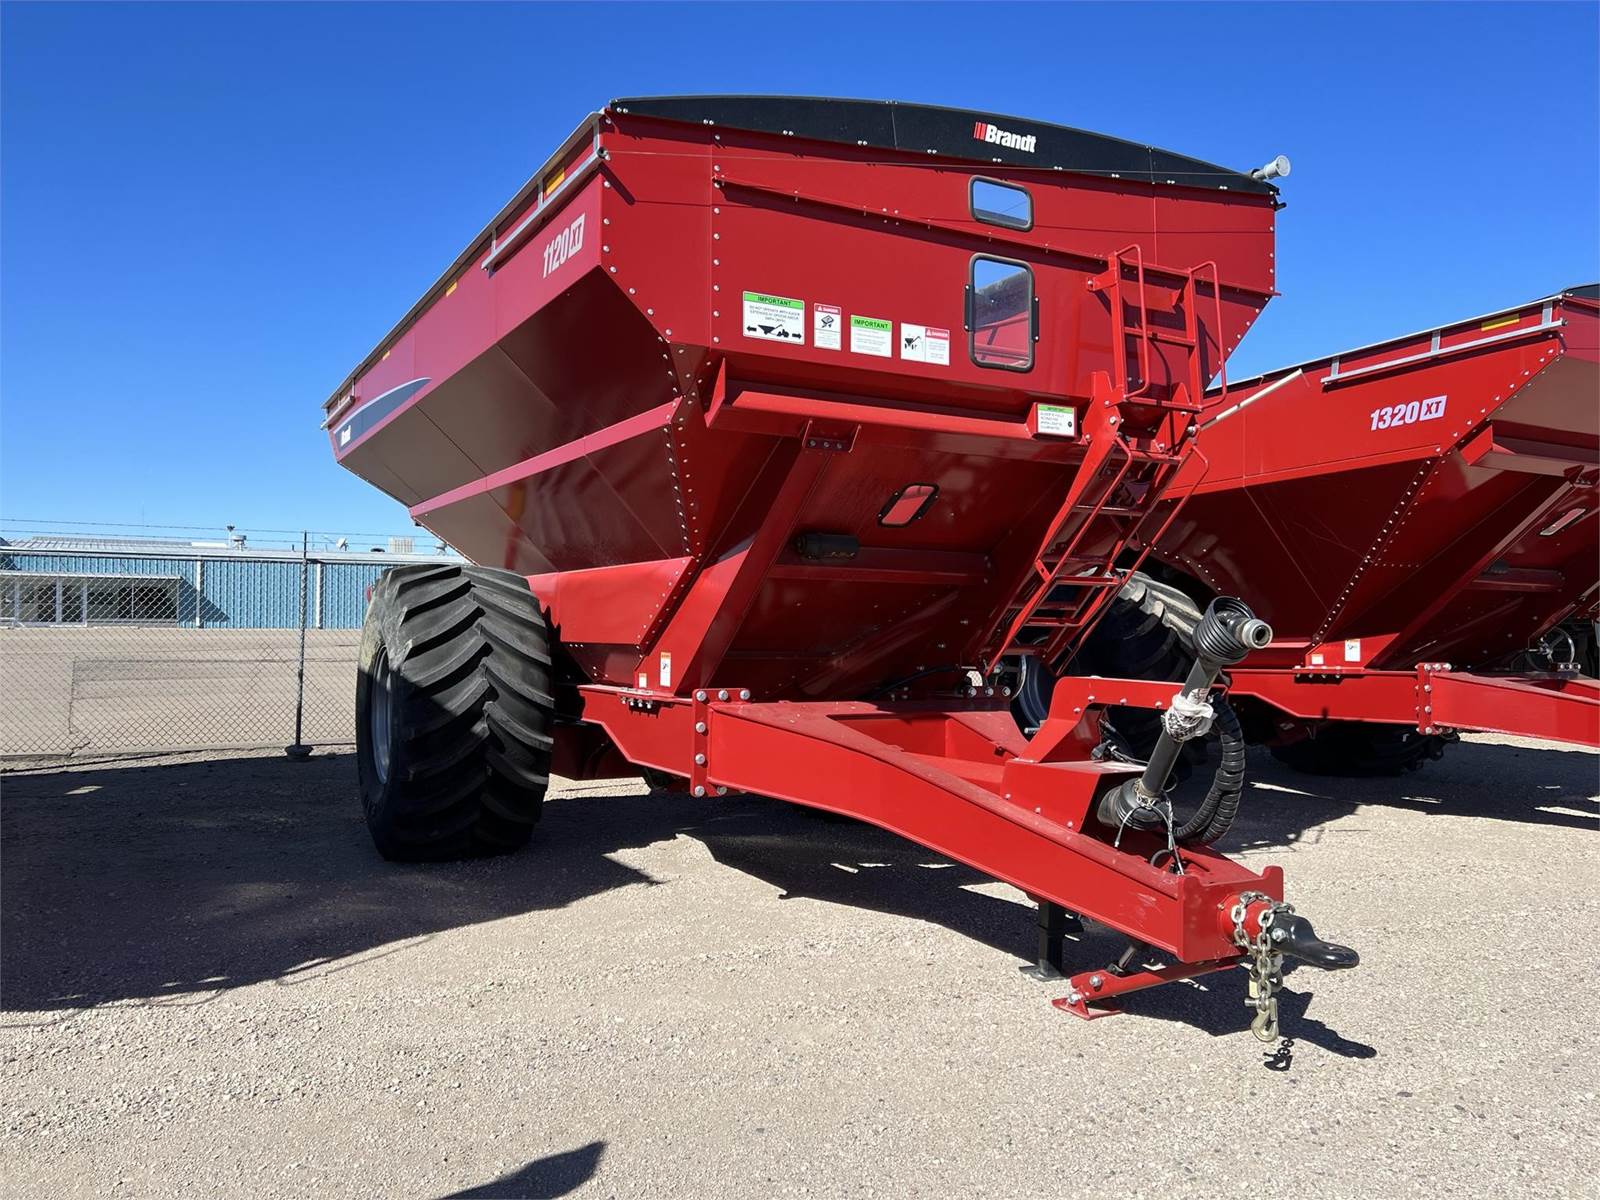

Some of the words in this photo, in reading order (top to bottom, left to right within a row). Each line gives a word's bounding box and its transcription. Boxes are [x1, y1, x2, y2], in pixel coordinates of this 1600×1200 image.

[985, 124, 1036, 153] Brandt
[757, 296, 792, 306] IMPORTANT
[854, 318, 889, 329] IMPORTANT
